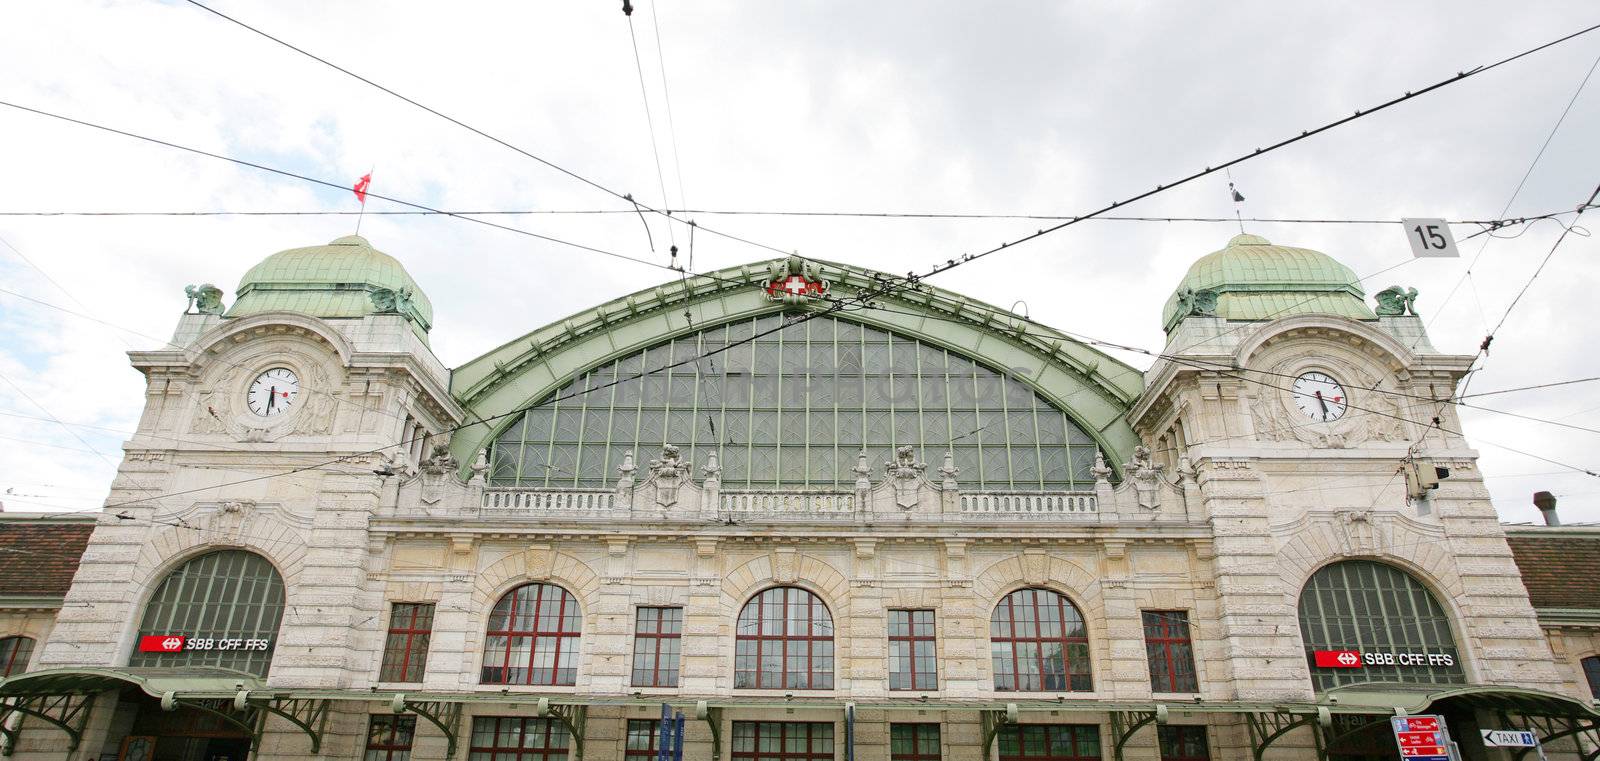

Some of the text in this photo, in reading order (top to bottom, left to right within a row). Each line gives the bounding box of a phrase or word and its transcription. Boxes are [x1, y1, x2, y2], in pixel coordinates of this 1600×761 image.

[1414, 225, 1446, 249] 15
[186, 639, 268, 651] SBB CFF FFS
[1364, 652, 1454, 667] SBB CFF FFS
[1496, 732, 1520, 744] TAXI
